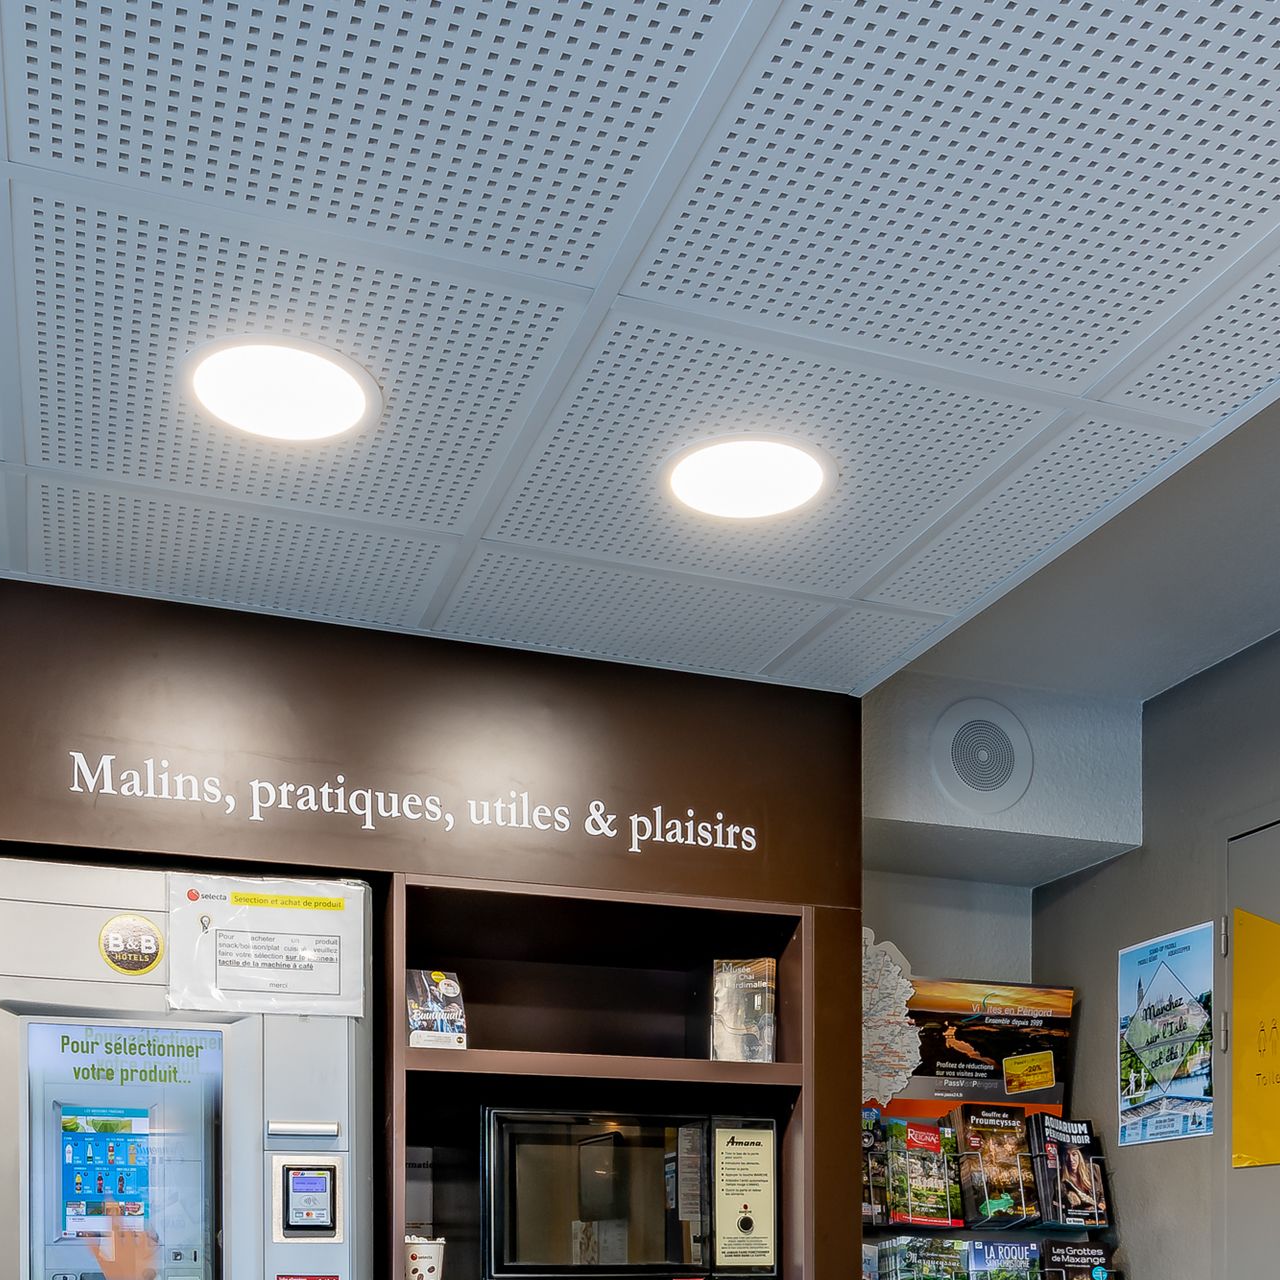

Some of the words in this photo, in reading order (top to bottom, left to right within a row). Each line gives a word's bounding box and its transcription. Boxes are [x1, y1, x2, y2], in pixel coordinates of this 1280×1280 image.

[69, 750, 235, 814] Malins,
[249, 775, 454, 832] pratiques,
[468, 792, 570, 833] utiles
[585, 800, 618, 838] &
[628, 808, 758, 852] plaisirs
[201, 892, 227, 901] selecta
[109, 932, 156, 955] B&B
[114, 952, 150, 962] HOTELS
[723, 963, 751, 973] Musée
[1142, 996, 1184, 1022] Marchez
[1145, 1033, 1160, 1047] sur
[1162, 1022, 1188, 1040] l'Isle
[61, 1035, 100, 1055] Pour
[1150, 1054, 1164, 1069] cet
[1165, 1049, 1179, 1063] été
[73, 1065, 114, 1081] votre
[971, 1116, 1021, 1128] Proumeyssac
[1045, 1116, 1088, 1135] AQUARIUM
[726, 1136, 761, 1146] Amana
[907, 1128, 939, 1144] REIGNAC
[984, 1246, 996, 1260] LA
[998, 1246, 1030, 1260] ROQUE
[1062, 1247, 1104, 1256] Grottes
[1061, 1255, 1106, 1265] Maxange
